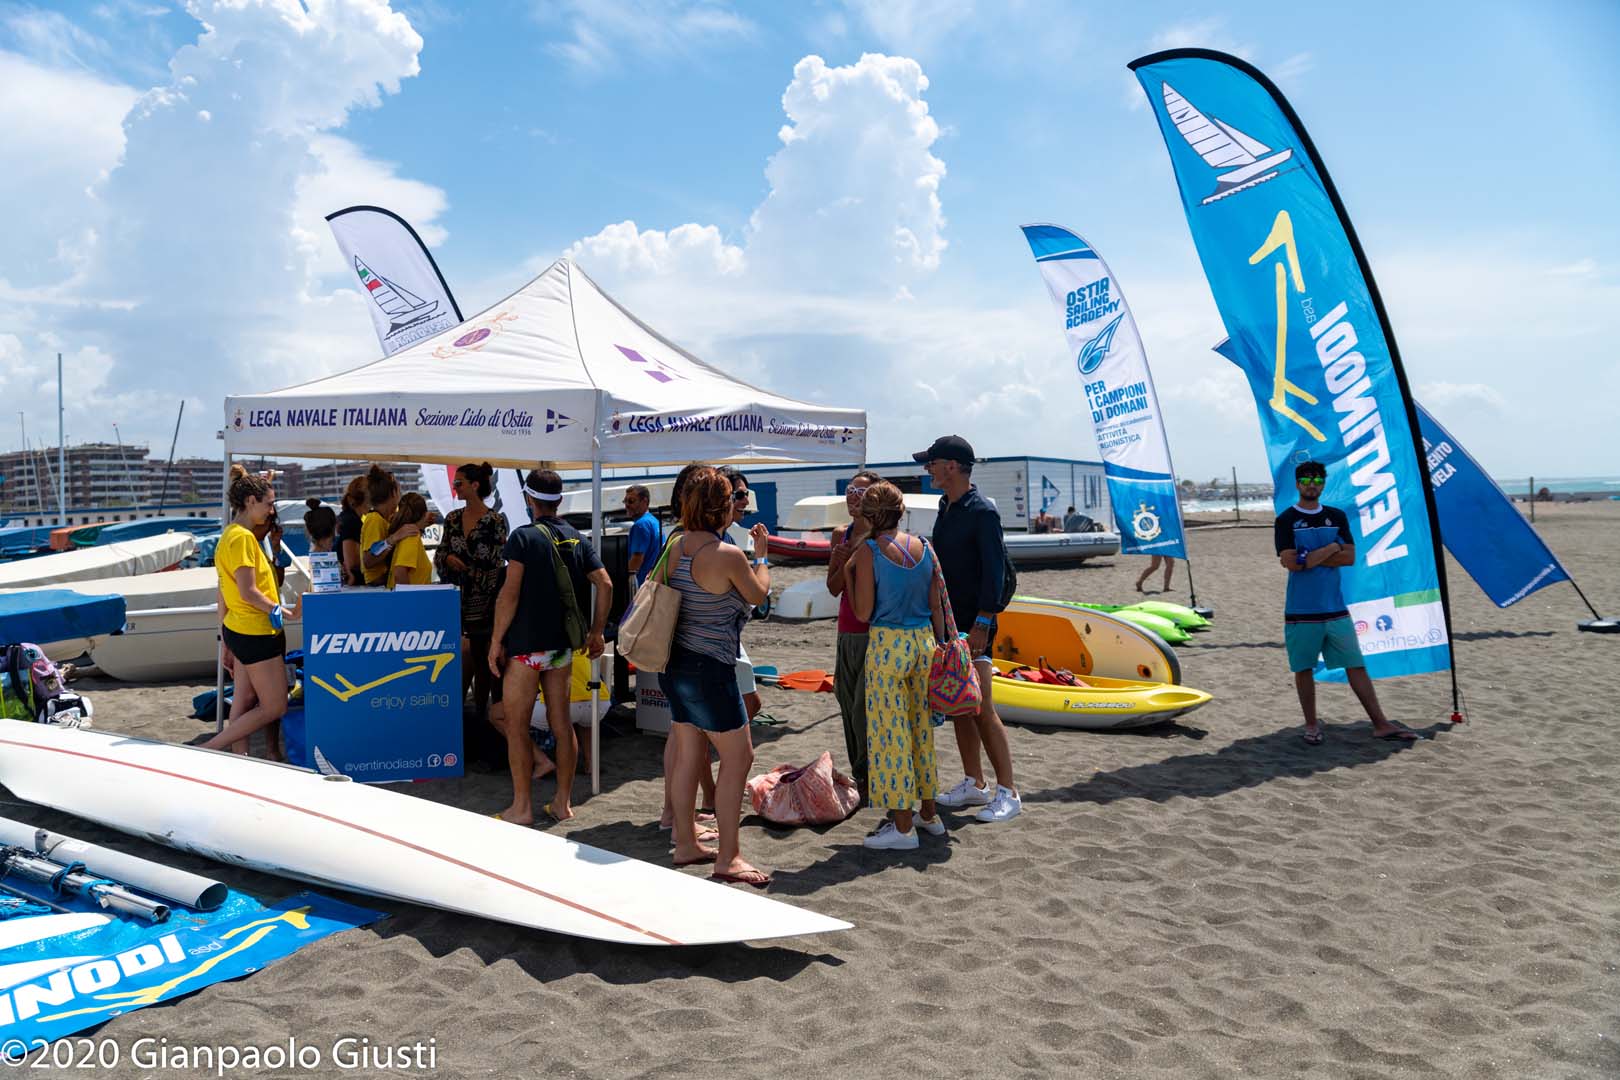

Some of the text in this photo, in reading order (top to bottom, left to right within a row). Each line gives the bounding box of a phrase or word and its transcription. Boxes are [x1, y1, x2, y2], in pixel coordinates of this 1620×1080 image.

[1066, 277, 1110, 307] OSTIA
[1066, 293, 1110, 318] SAILING
[1066, 298, 1121, 330] ACADEMY
[1084, 380, 1107, 398] PER
[1095, 381, 1148, 407] CAMPIONI
[250, 407, 534, 428] LEGA NAVALE ITALIANA Sezione Lido di Ostia
[1092, 396, 1149, 424] DI DOMANI
[629, 415, 664, 432] LEGA
[715, 414, 764, 432] ITALIANA
[310, 630, 446, 655] VENTINODI
[370, 693, 449, 710] enjoy sailing
[344, 757, 423, 773] @ventinodiasd
[188, 940, 224, 957] asd
